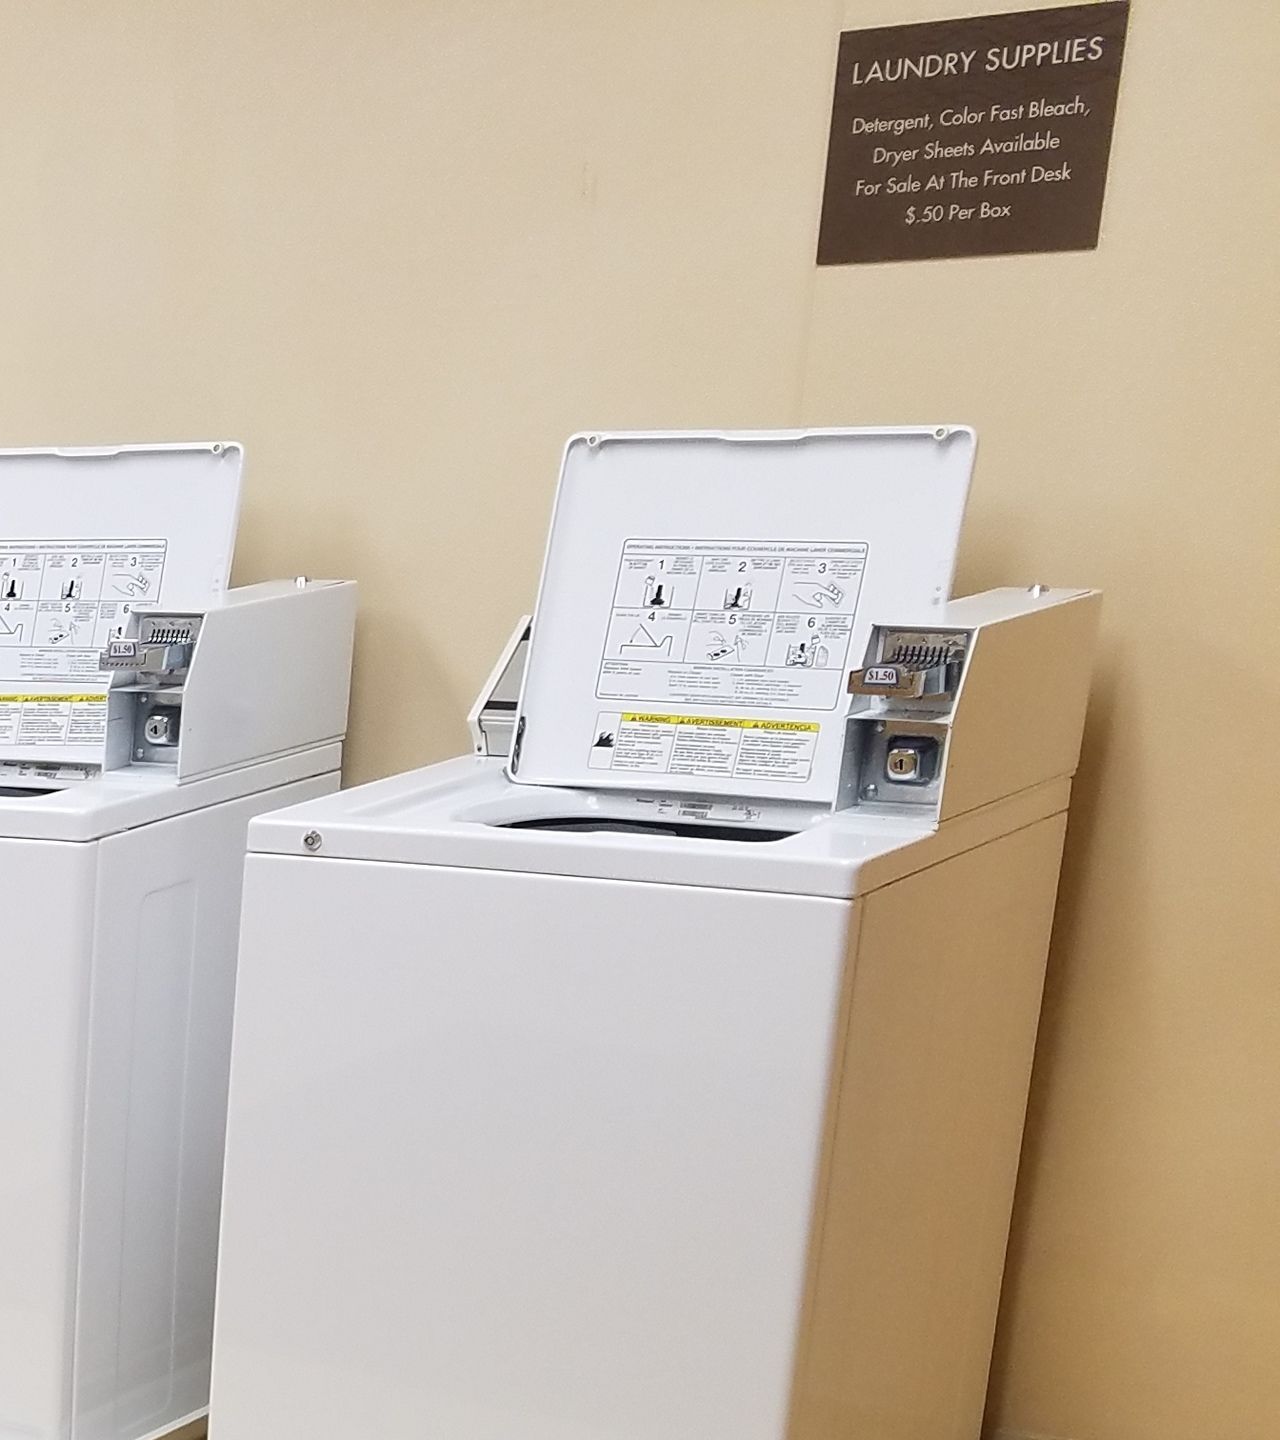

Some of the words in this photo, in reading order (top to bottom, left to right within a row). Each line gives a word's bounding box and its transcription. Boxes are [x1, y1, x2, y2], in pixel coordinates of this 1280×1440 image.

[852, 50, 977, 85] LAUNDRY
[985, 35, 1104, 72] SUPPLIES
[852, 113, 935, 135] Detergent,
[940, 106, 986, 126] Color
[990, 103, 1024, 122] Fast
[1028, 95, 1090, 118] Bleach,
[873, 146, 919, 166] Dryer
[924, 140, 974, 159] Sheets
[980, 131, 1060, 155] Available
[855, 180, 882, 196] For
[887, 175, 921, 194] Sale
[925, 174, 945, 190] At
[951, 170, 978, 189] The
[983, 170, 1027, 186] Front
[1031, 162, 1072, 183] Desk
[905, 205, 944, 225] $.50
[949, 204, 975, 220] Per
[980, 202, 1011, 218] Box
[12, 558, 17, 567] 1
[71, 558, 78, 567] 2
[130, 557, 137, 566] 3
[658, 559, 665, 570] 1
[738, 562, 747, 572] 2
[818, 562, 827, 574] 3
[4, 603, 10, 612] 4
[65, 604, 71, 612] 5
[123, 604, 130, 613] 6
[648, 612, 656, 621] 4
[728, 614, 737, 624] 5
[807, 617, 816, 628] 6
[113, 646, 131, 654] $1.50
[868, 671, 894, 681] $1.50
[638, 716, 671, 724] WARNING
[686, 718, 743, 727] AVERTISSEMENT
[760, 722, 812, 731] ADVERTENCIA
